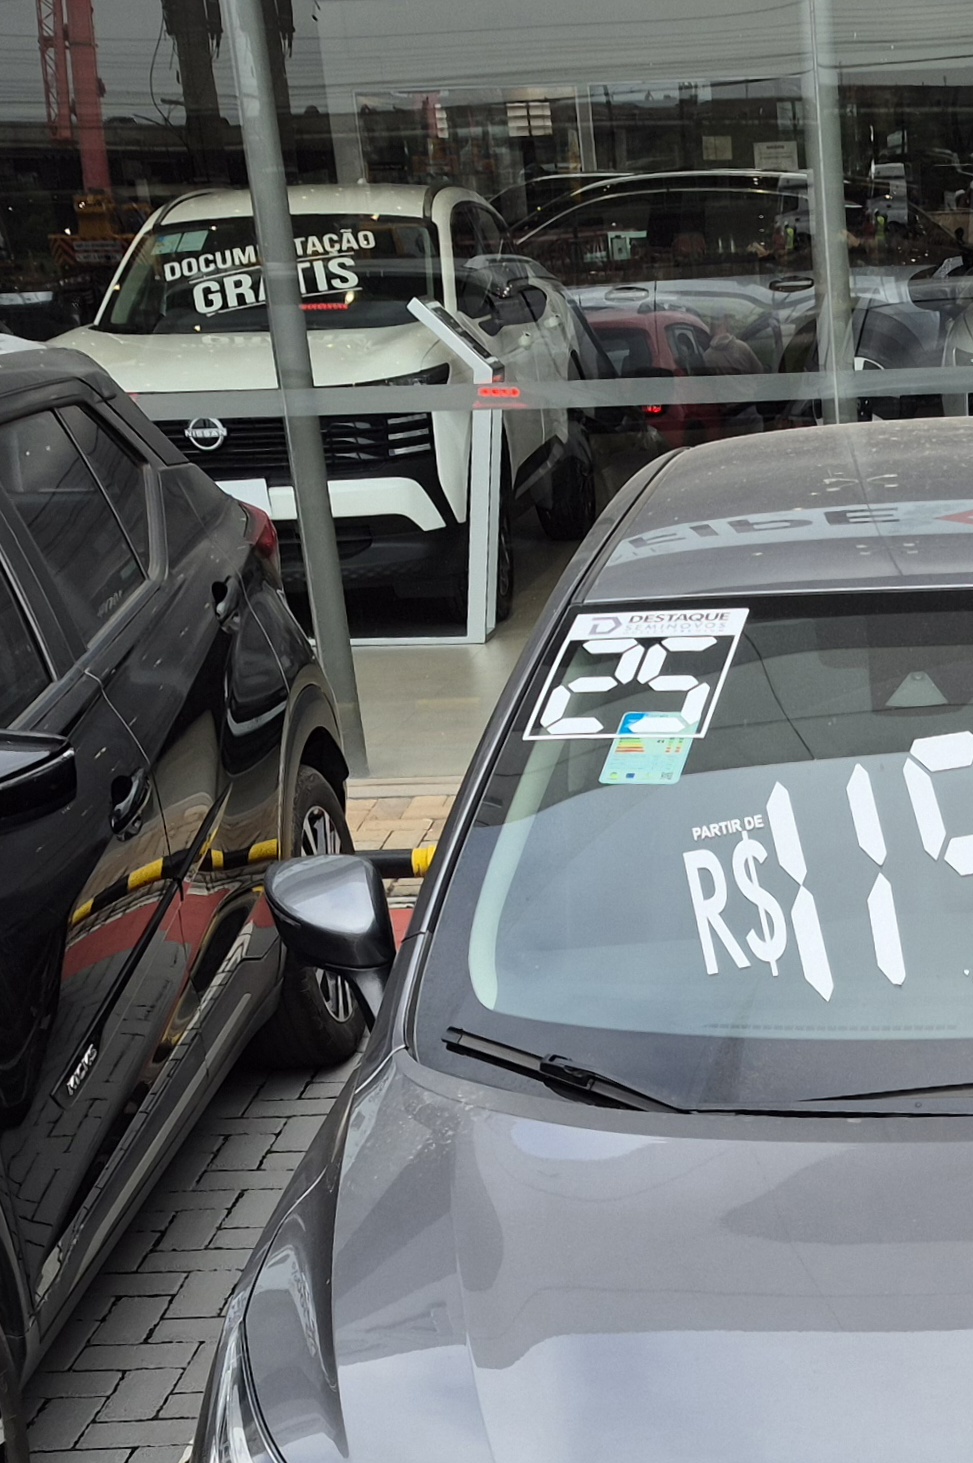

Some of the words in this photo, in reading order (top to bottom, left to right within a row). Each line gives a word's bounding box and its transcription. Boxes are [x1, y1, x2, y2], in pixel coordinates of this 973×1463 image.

[164, 228, 376, 282] DOCUMTAÇÃO
[193, 257, 359, 315] GRTIS
[184, 428, 228, 438] NISSAN
[625, 622, 727, 631] SEMINOVOS
[629, 612, 731, 624] DESTAQUE
[540, 635, 717, 735] 25
[692, 819, 743, 841] PARTIR
[744, 814, 764, 831] DE
